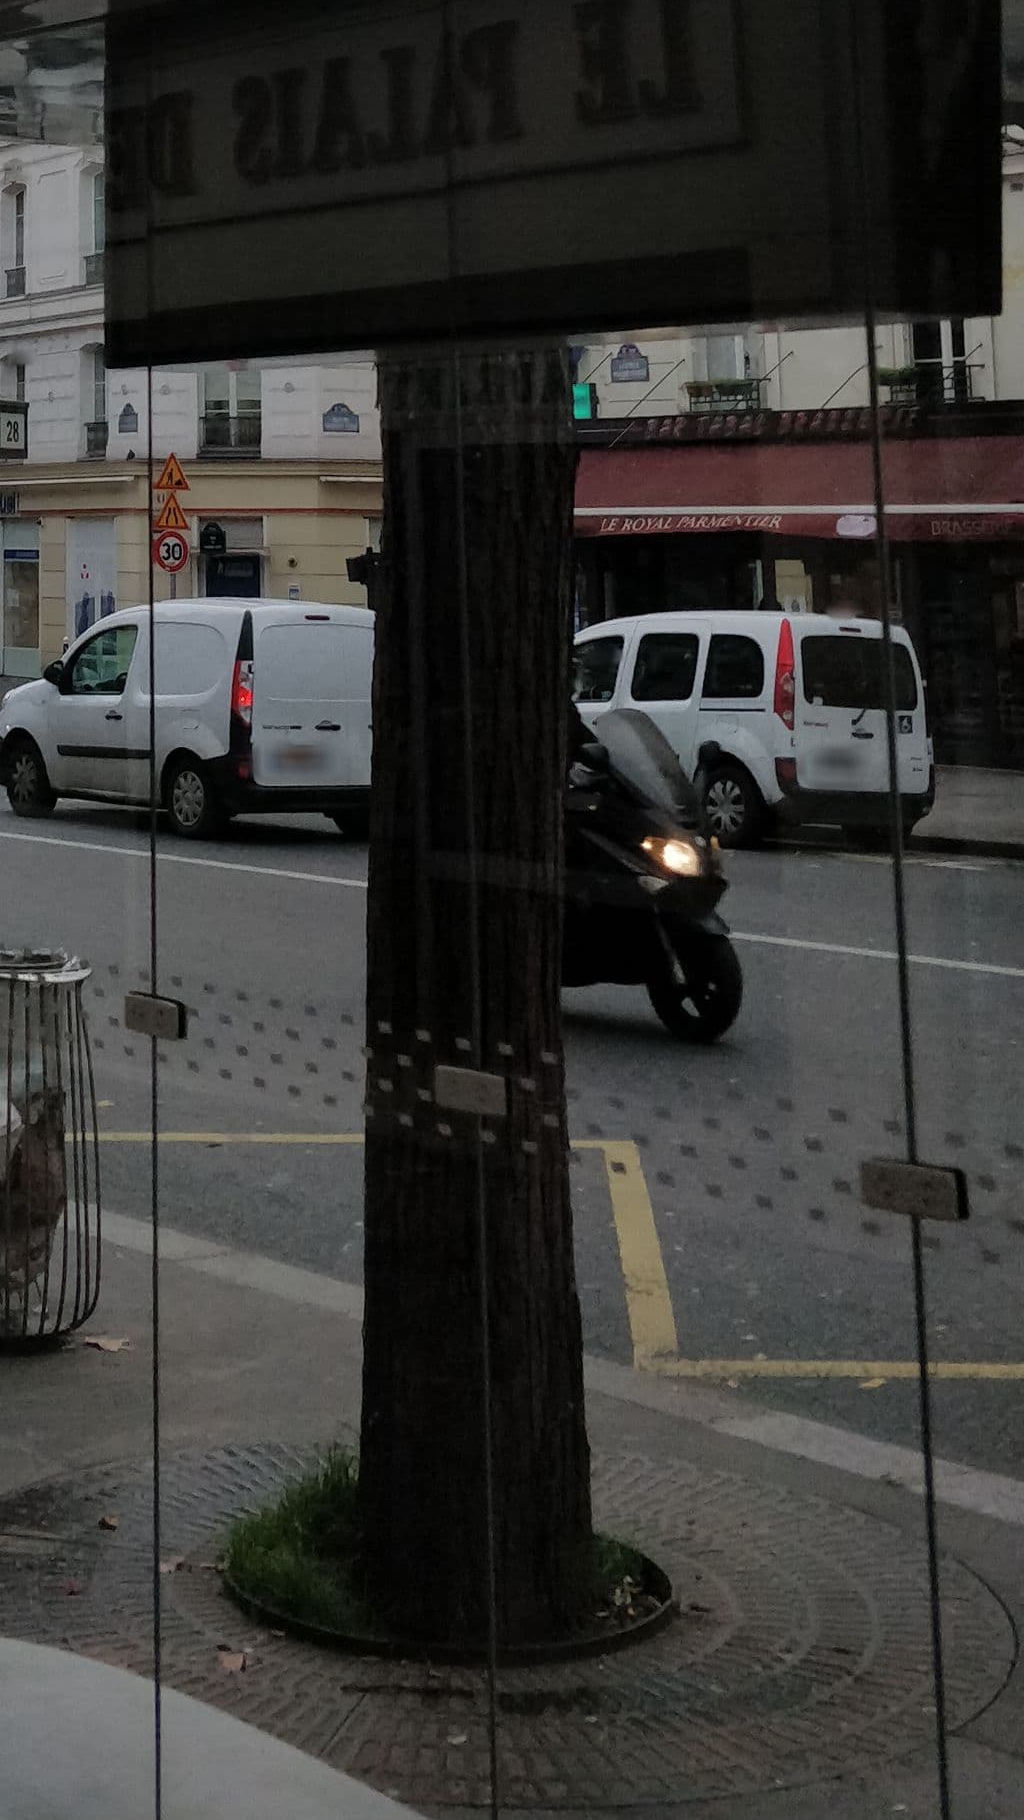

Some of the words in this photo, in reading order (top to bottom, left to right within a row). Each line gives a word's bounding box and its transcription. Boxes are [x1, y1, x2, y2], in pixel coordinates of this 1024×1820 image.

[6, 420, 19, 442] 28
[599, 517, 617, 533] LE
[621, 516, 673, 532] ROYAL
[676, 513, 783, 530] PARMENTIER
[161, 542, 182, 561] 30
